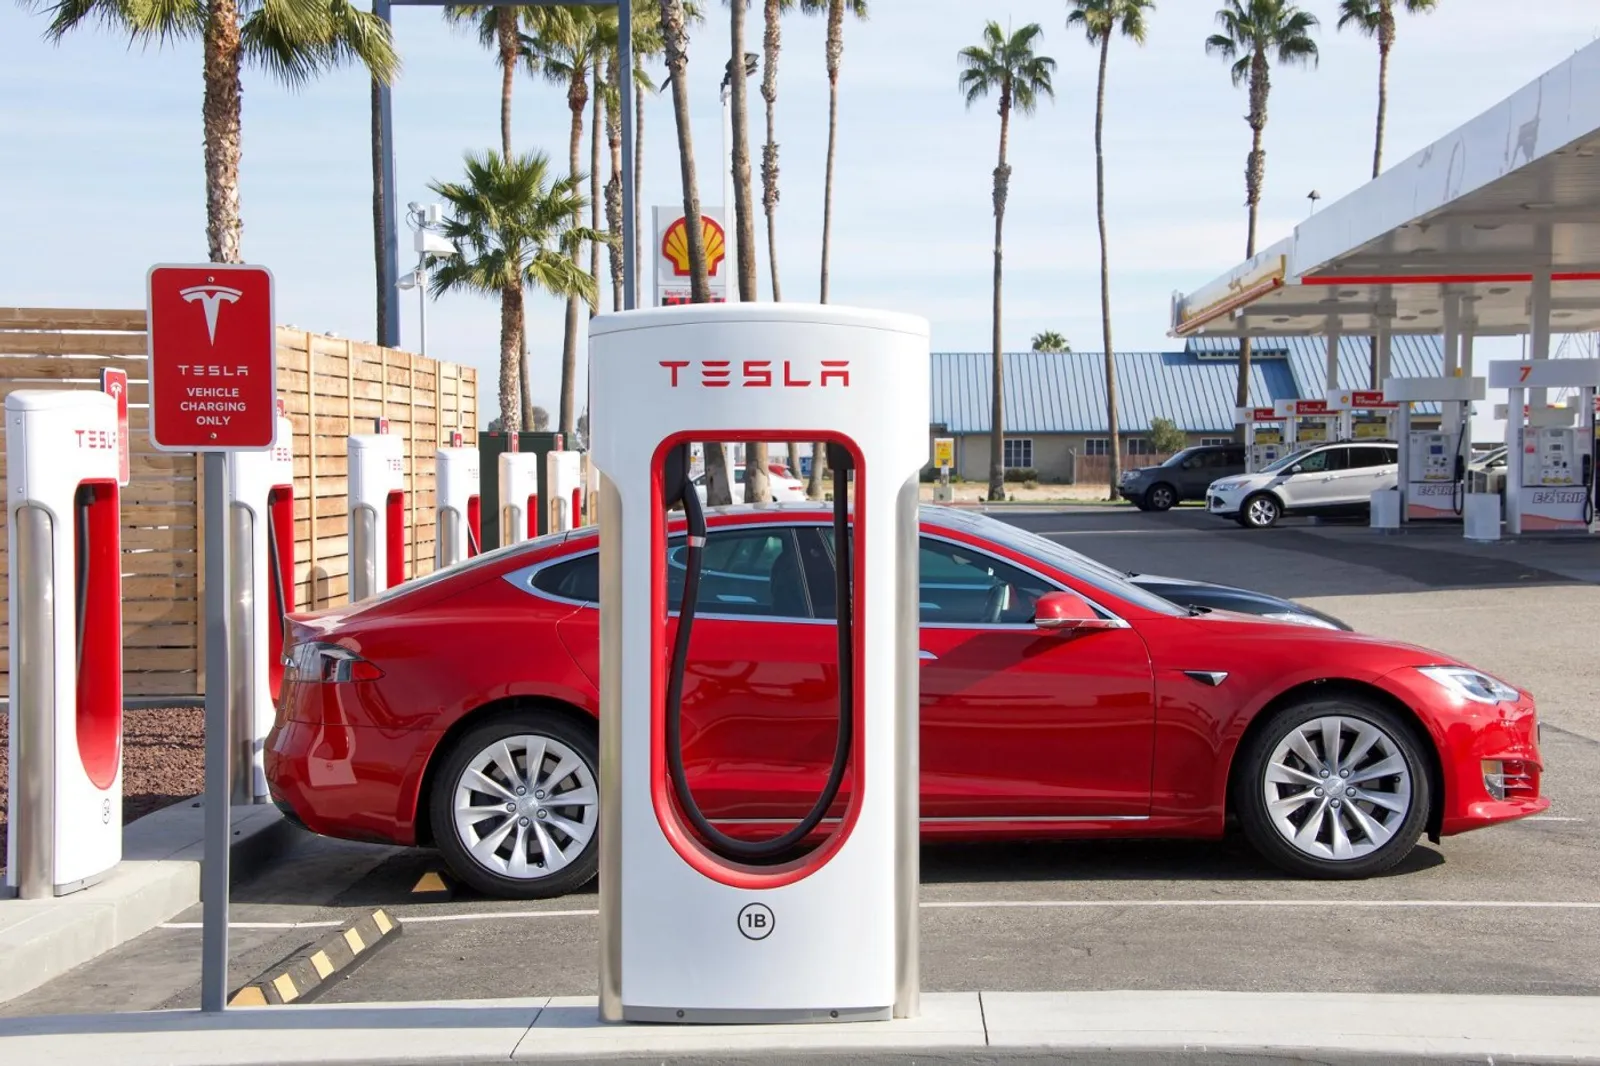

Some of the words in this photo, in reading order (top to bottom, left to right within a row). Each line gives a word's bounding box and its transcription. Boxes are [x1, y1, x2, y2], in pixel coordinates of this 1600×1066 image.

[177, 365, 249, 376] TESLA
[658, 360, 850, 387] TESLA
[1519, 366, 1532, 382] 7
[186, 387, 240, 397] VEHICLE
[180, 401, 246, 412] CHARGING
[196, 416, 231, 426] ONLY
[745, 913, 767, 928] 1B
